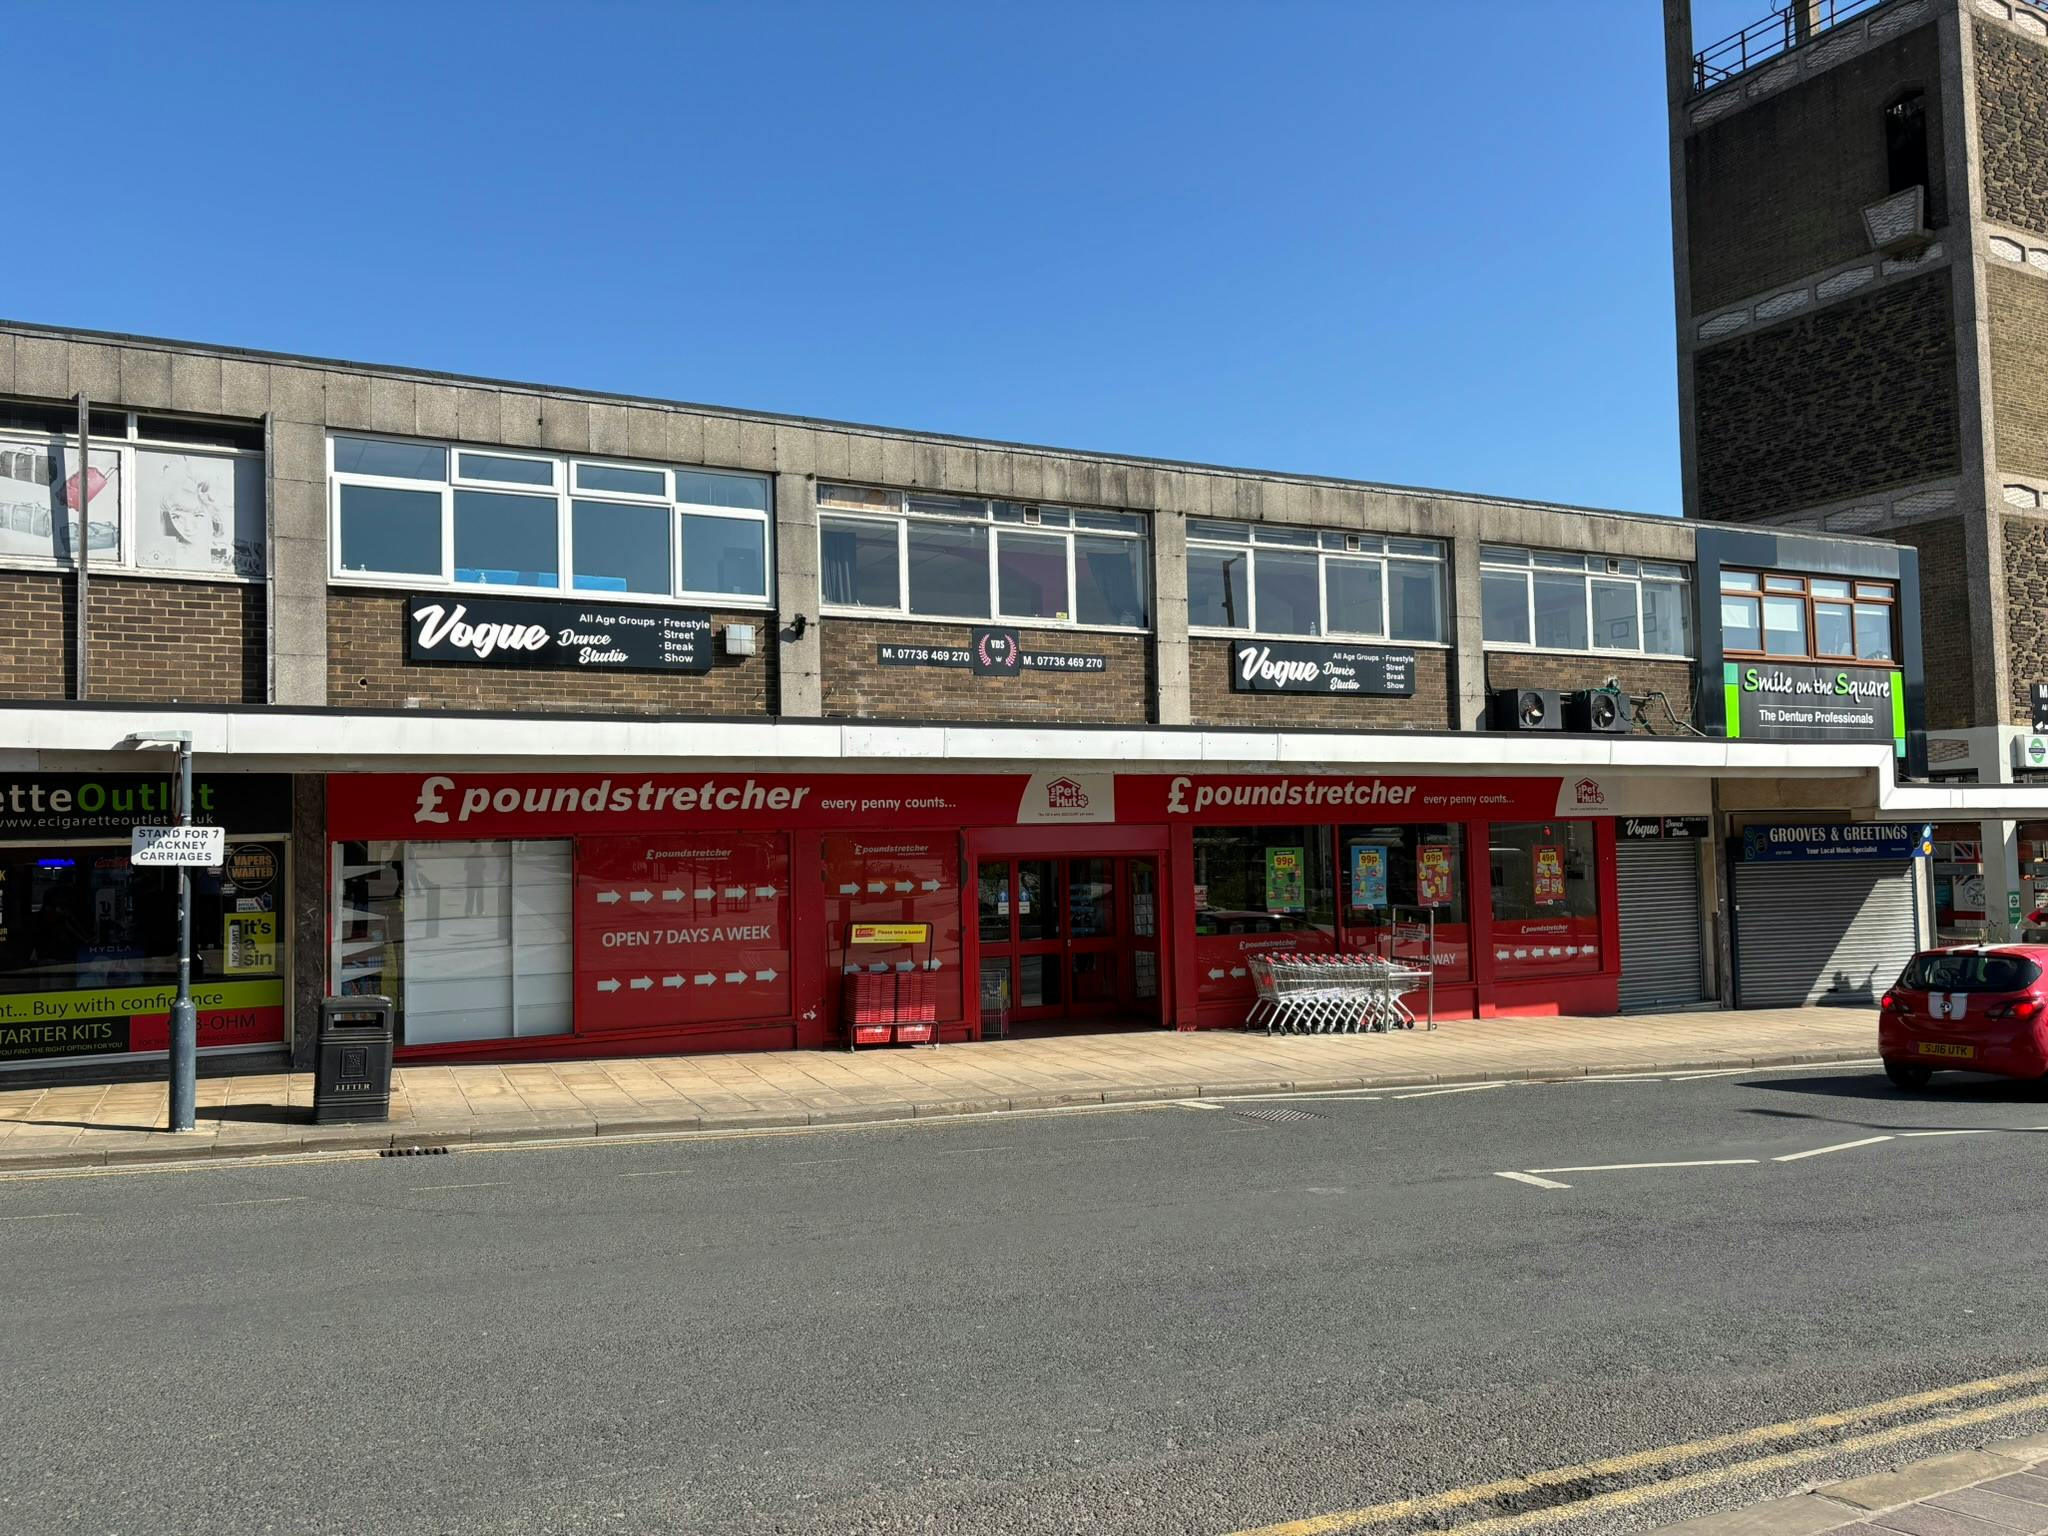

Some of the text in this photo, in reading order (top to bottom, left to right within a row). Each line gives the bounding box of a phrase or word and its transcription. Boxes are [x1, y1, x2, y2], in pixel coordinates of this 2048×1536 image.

[579, 613, 655, 627] All Age Groups
[664, 618, 710, 629] Freestyle
[412, 604, 550, 658] Vogue
[664, 630, 694, 640] Street
[557, 629, 611, 646] Dance
[664, 641, 694, 651] Break
[579, 647, 628, 664] Studio
[664, 653, 693, 663] Show
[882, 648, 970, 662] M. 07736 469 270
[1343, 653, 1356, 663] Age
[1356, 654, 1379, 662] Groups
[1385, 655, 1414, 664] Freestyle
[1023, 656, 1103, 669] M. 07736 469 270
[1239, 647, 1319, 688] Vogue
[1322, 661, 1356, 677] Dance
[1330, 676, 1360, 691] Studio
[1744, 668, 1890, 703] Smile on the Square
[1759, 709, 1873, 725] The Denture Professionals
[1056, 785, 1077, 796] Pet
[1582, 785, 1597, 794] Pet
[821, 796, 957, 812] every penny counts...
[1056, 796, 1077, 807] Hut
[1423, 793, 1515, 805] every penny counts...
[139, 829, 219, 839] STAND FOR 7
[1626, 819, 1659, 838] Vogue
[1769, 826, 1907, 842] GROOVES & GREETINGS
[147, 841, 207, 850] HACKNEY
[140, 851, 212, 861] CARRIAGES
[234, 855, 273, 866] VAPERS
[1276, 856, 1293, 866] 99p
[1360, 855, 1377, 865] 99p
[1426, 854, 1441, 864] 99p
[1541, 854, 1555, 863] 49p
[232, 867, 274, 878] WANTED
[244, 919, 272, 935] it's
[602, 925, 771, 948] OPEN 7 DAYS A WEEK
[244, 938, 257, 950] a
[243, 951, 273, 966] sin
[1431, 952, 1456, 966] WAY
[33, 1001, 68, 1017] Buy
[75, 997, 115, 1013] with
[72, 1023, 113, 1040] KITS
[32, 1046, 45, 1054] THE
[45, 1045, 65, 1053] RIGHT
[67, 1043, 92, 1052] OPTION
[94, 1042, 107, 1050] FOR
[108, 1041, 123, 1049] YOU
[1947, 1045, 1968, 1056] UTK
